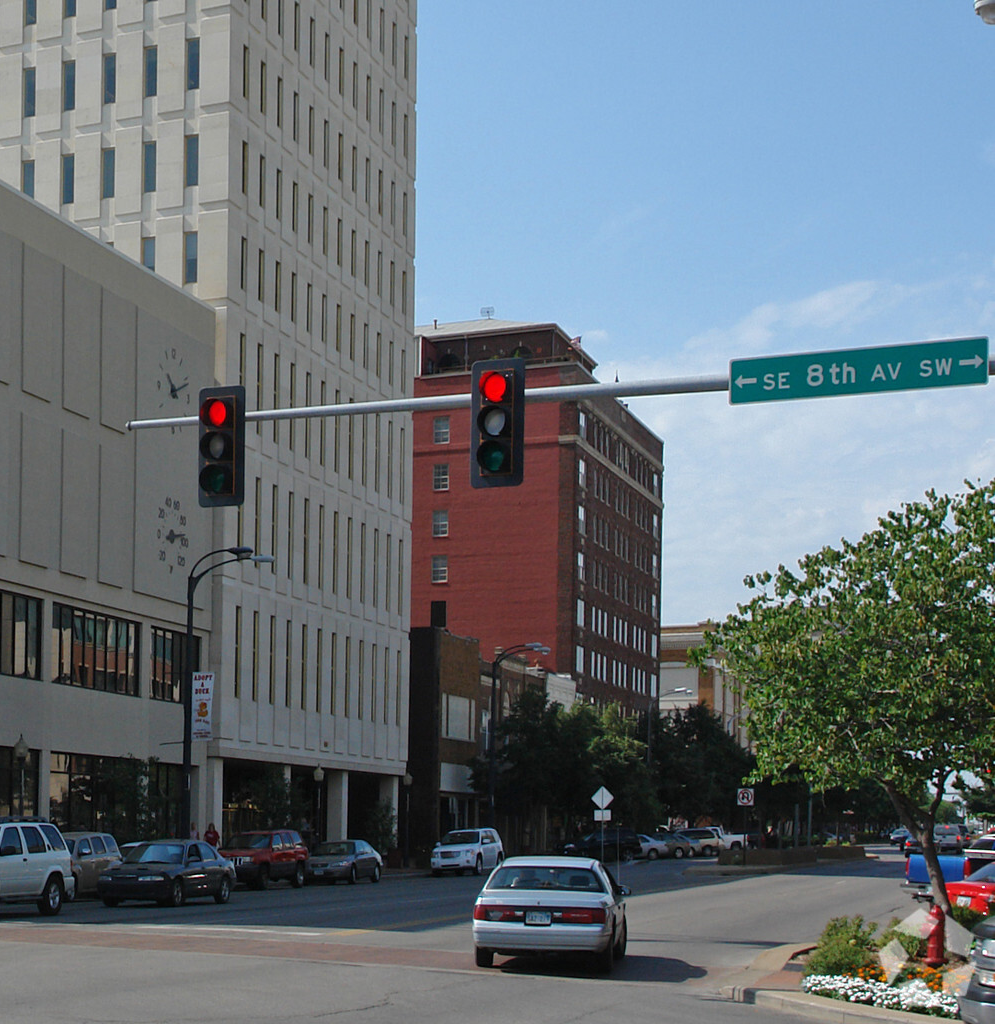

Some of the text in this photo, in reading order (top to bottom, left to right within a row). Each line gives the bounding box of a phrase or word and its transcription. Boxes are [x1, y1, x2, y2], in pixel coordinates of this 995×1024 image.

[762, 357, 953, 391] SE 8th AV SW
